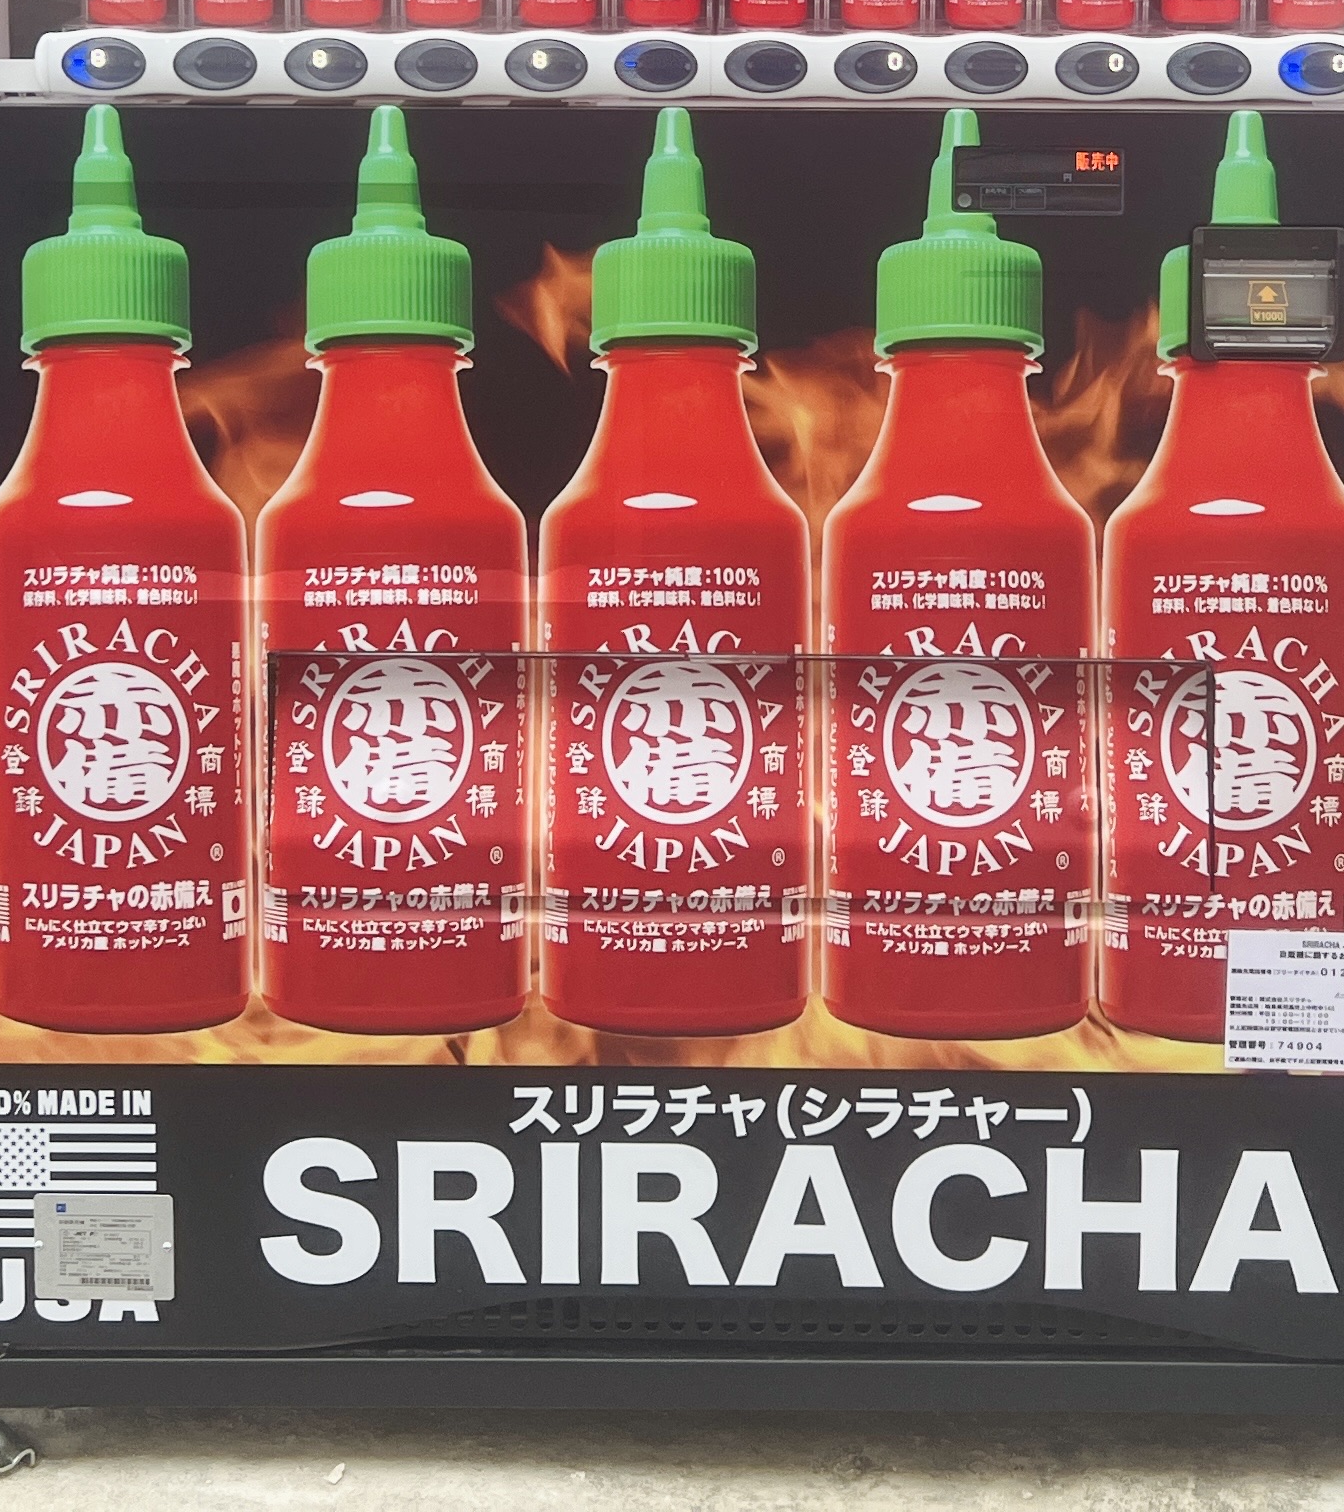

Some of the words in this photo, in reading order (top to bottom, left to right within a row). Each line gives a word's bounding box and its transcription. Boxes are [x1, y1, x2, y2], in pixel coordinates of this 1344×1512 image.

[1076, 151, 1119, 171] 販売中
[5, 617, 221, 734] SRIRACHA
[34, 813, 187, 868] JAPAN
[312, 814, 467, 871] JAPAN
[595, 815, 749, 873] JAPAN
[878, 818, 1033, 876] JAPAN
[1158, 821, 1311, 878] JAPAN
[22, 879, 212, 911] スリラチャの赤備え
[301, 883, 491, 912] スリラチャの赤備え
[582, 885, 772, 913] スリラチャの赤備え
[863, 888, 1055, 916] スリラチャの赤備え
[1142, 890, 1336, 920] スリラチャの赤備え
[25, 916, 206, 934] にんにく仕立てウマ辛すっぱい
[265, 925, 288, 943] USA
[303, 917, 484, 935] にんにく仕立てウマ辛すっぱい
[545, 926, 568, 944] USA
[583, 918, 765, 936] にんにく仕立てウマ辛すっぱい
[866, 921, 1048, 939] にんにく仕立てウマ辛すっぱい
[1145, 925, 1229, 942] にんにく仕立て
[113, 934, 190, 950] ホットソース
[391, 935, 468, 951] ホットソース
[672, 936, 748, 952] ホットソース
[827, 927, 850, 947] USA
[1105, 932, 1128, 950] USA
[954, 940, 1031, 955] ホットソース
[38, 1090, 115, 1117] MADE
[122, 1090, 152, 1116] IN
[259, 1136, 1339, 1293] SRIRACHA
